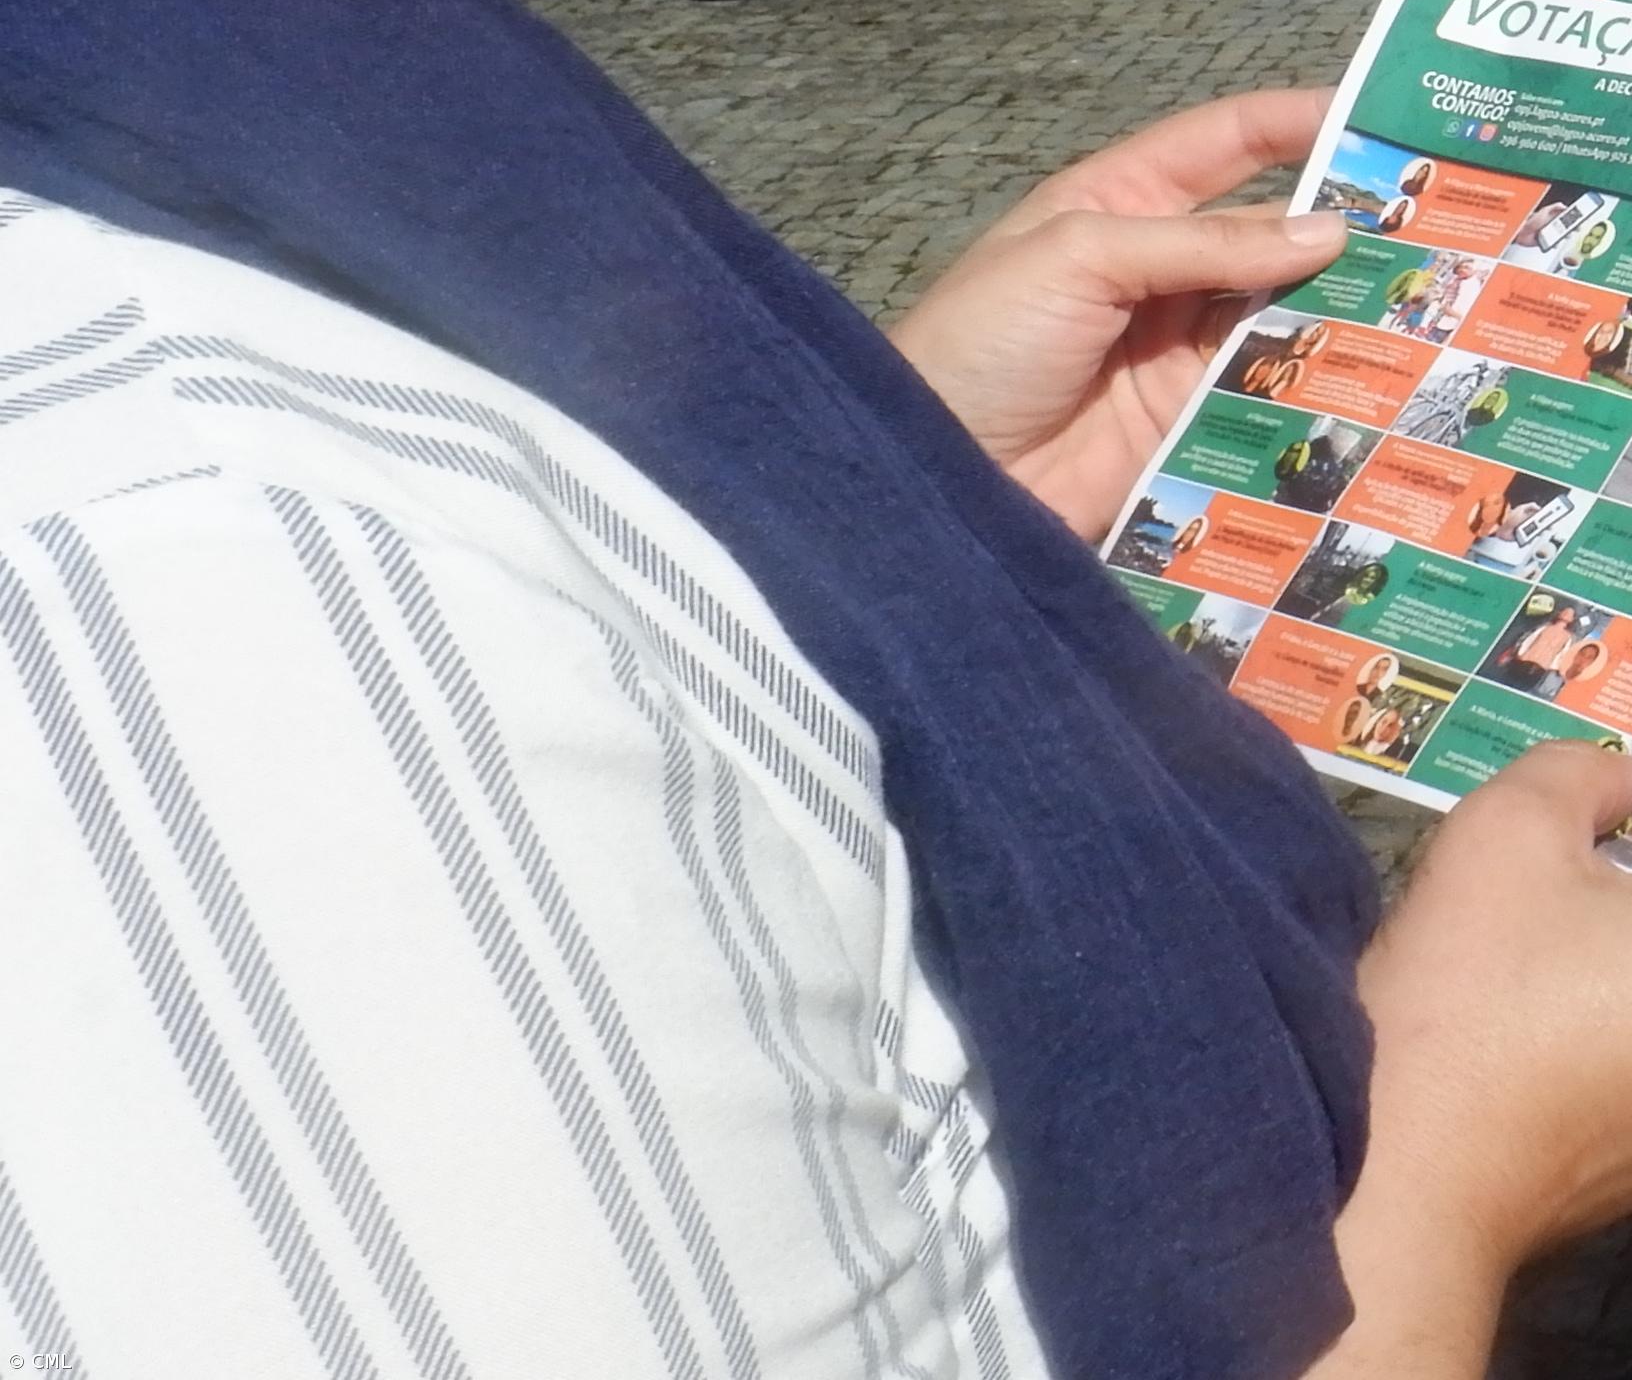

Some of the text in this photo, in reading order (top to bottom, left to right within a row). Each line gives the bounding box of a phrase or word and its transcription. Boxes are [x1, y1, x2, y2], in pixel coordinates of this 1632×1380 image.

[1422, 71, 1517, 106] CONTAMOS
[1594, 78, 1607, 91] A
[1431, 92, 1511, 122] CONTIGO!
